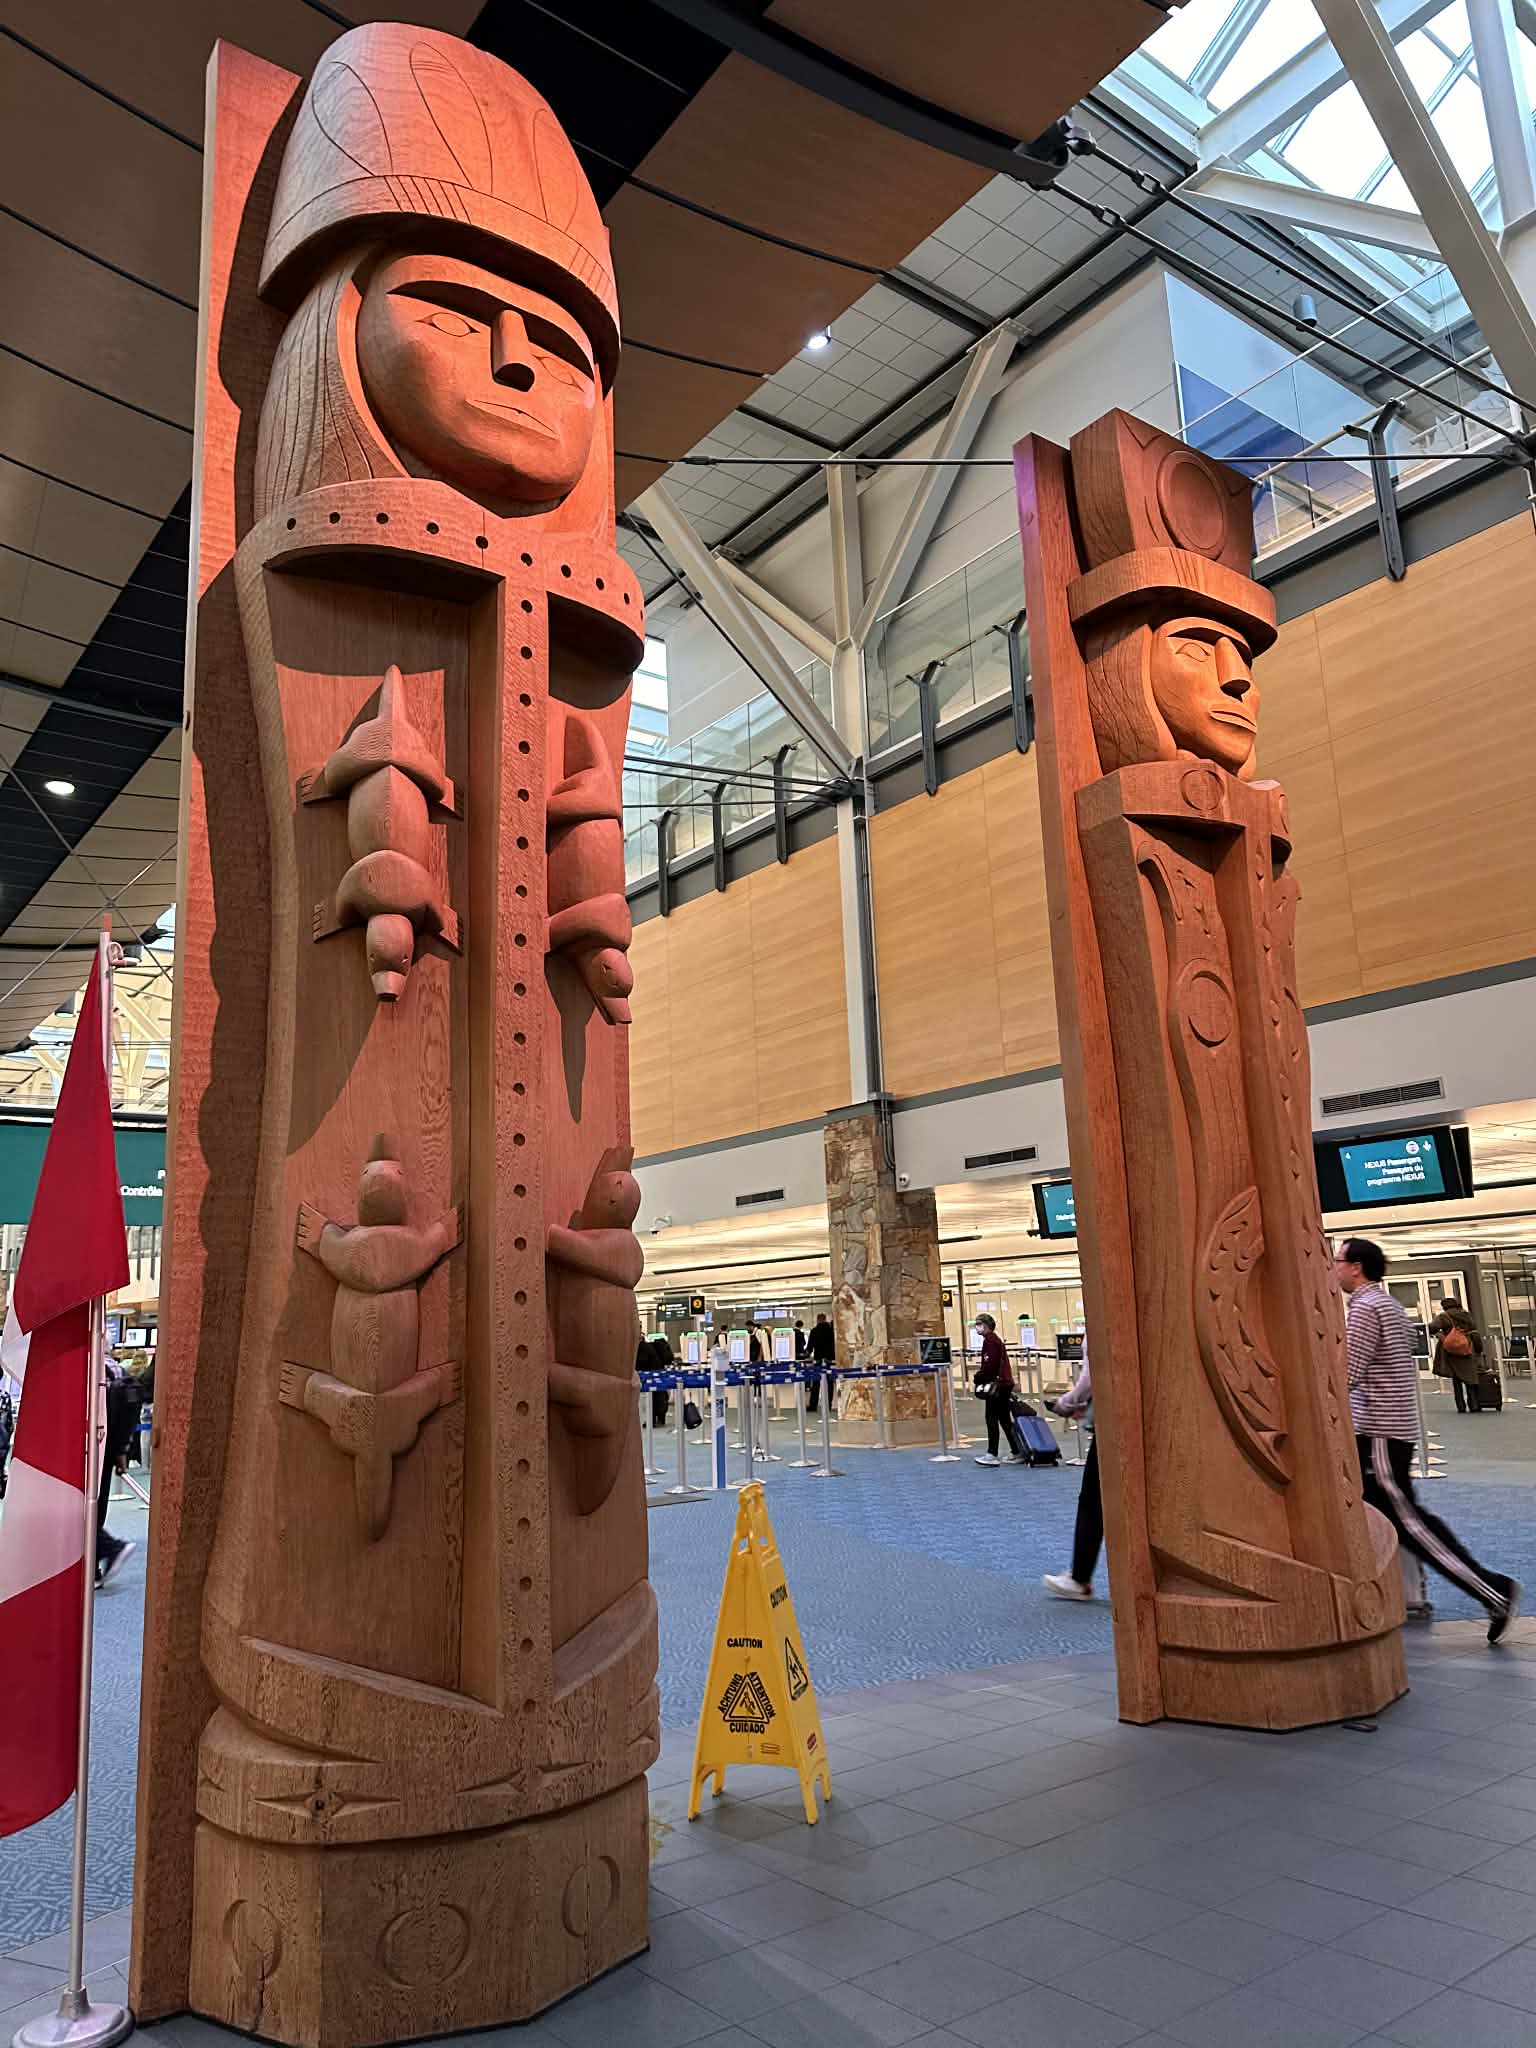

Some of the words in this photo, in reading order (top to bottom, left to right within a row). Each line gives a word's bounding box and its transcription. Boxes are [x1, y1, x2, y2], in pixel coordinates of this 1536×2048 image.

[1364, 1159, 1386, 1168] NEXUS
[1414, 1163, 1424, 1171] du
[1402, 1172, 1425, 1182] NEXUS
[120, 1185, 163, 1197] Contrôle
[770, 1583, 788, 1609] CAUTION
[727, 1638, 763, 1648] CAUTION
[718, 1673, 743, 1714] ACHTUNG
[749, 1671, 776, 1718] ATTENTION
[729, 1722, 765, 1734] CUIDADO
